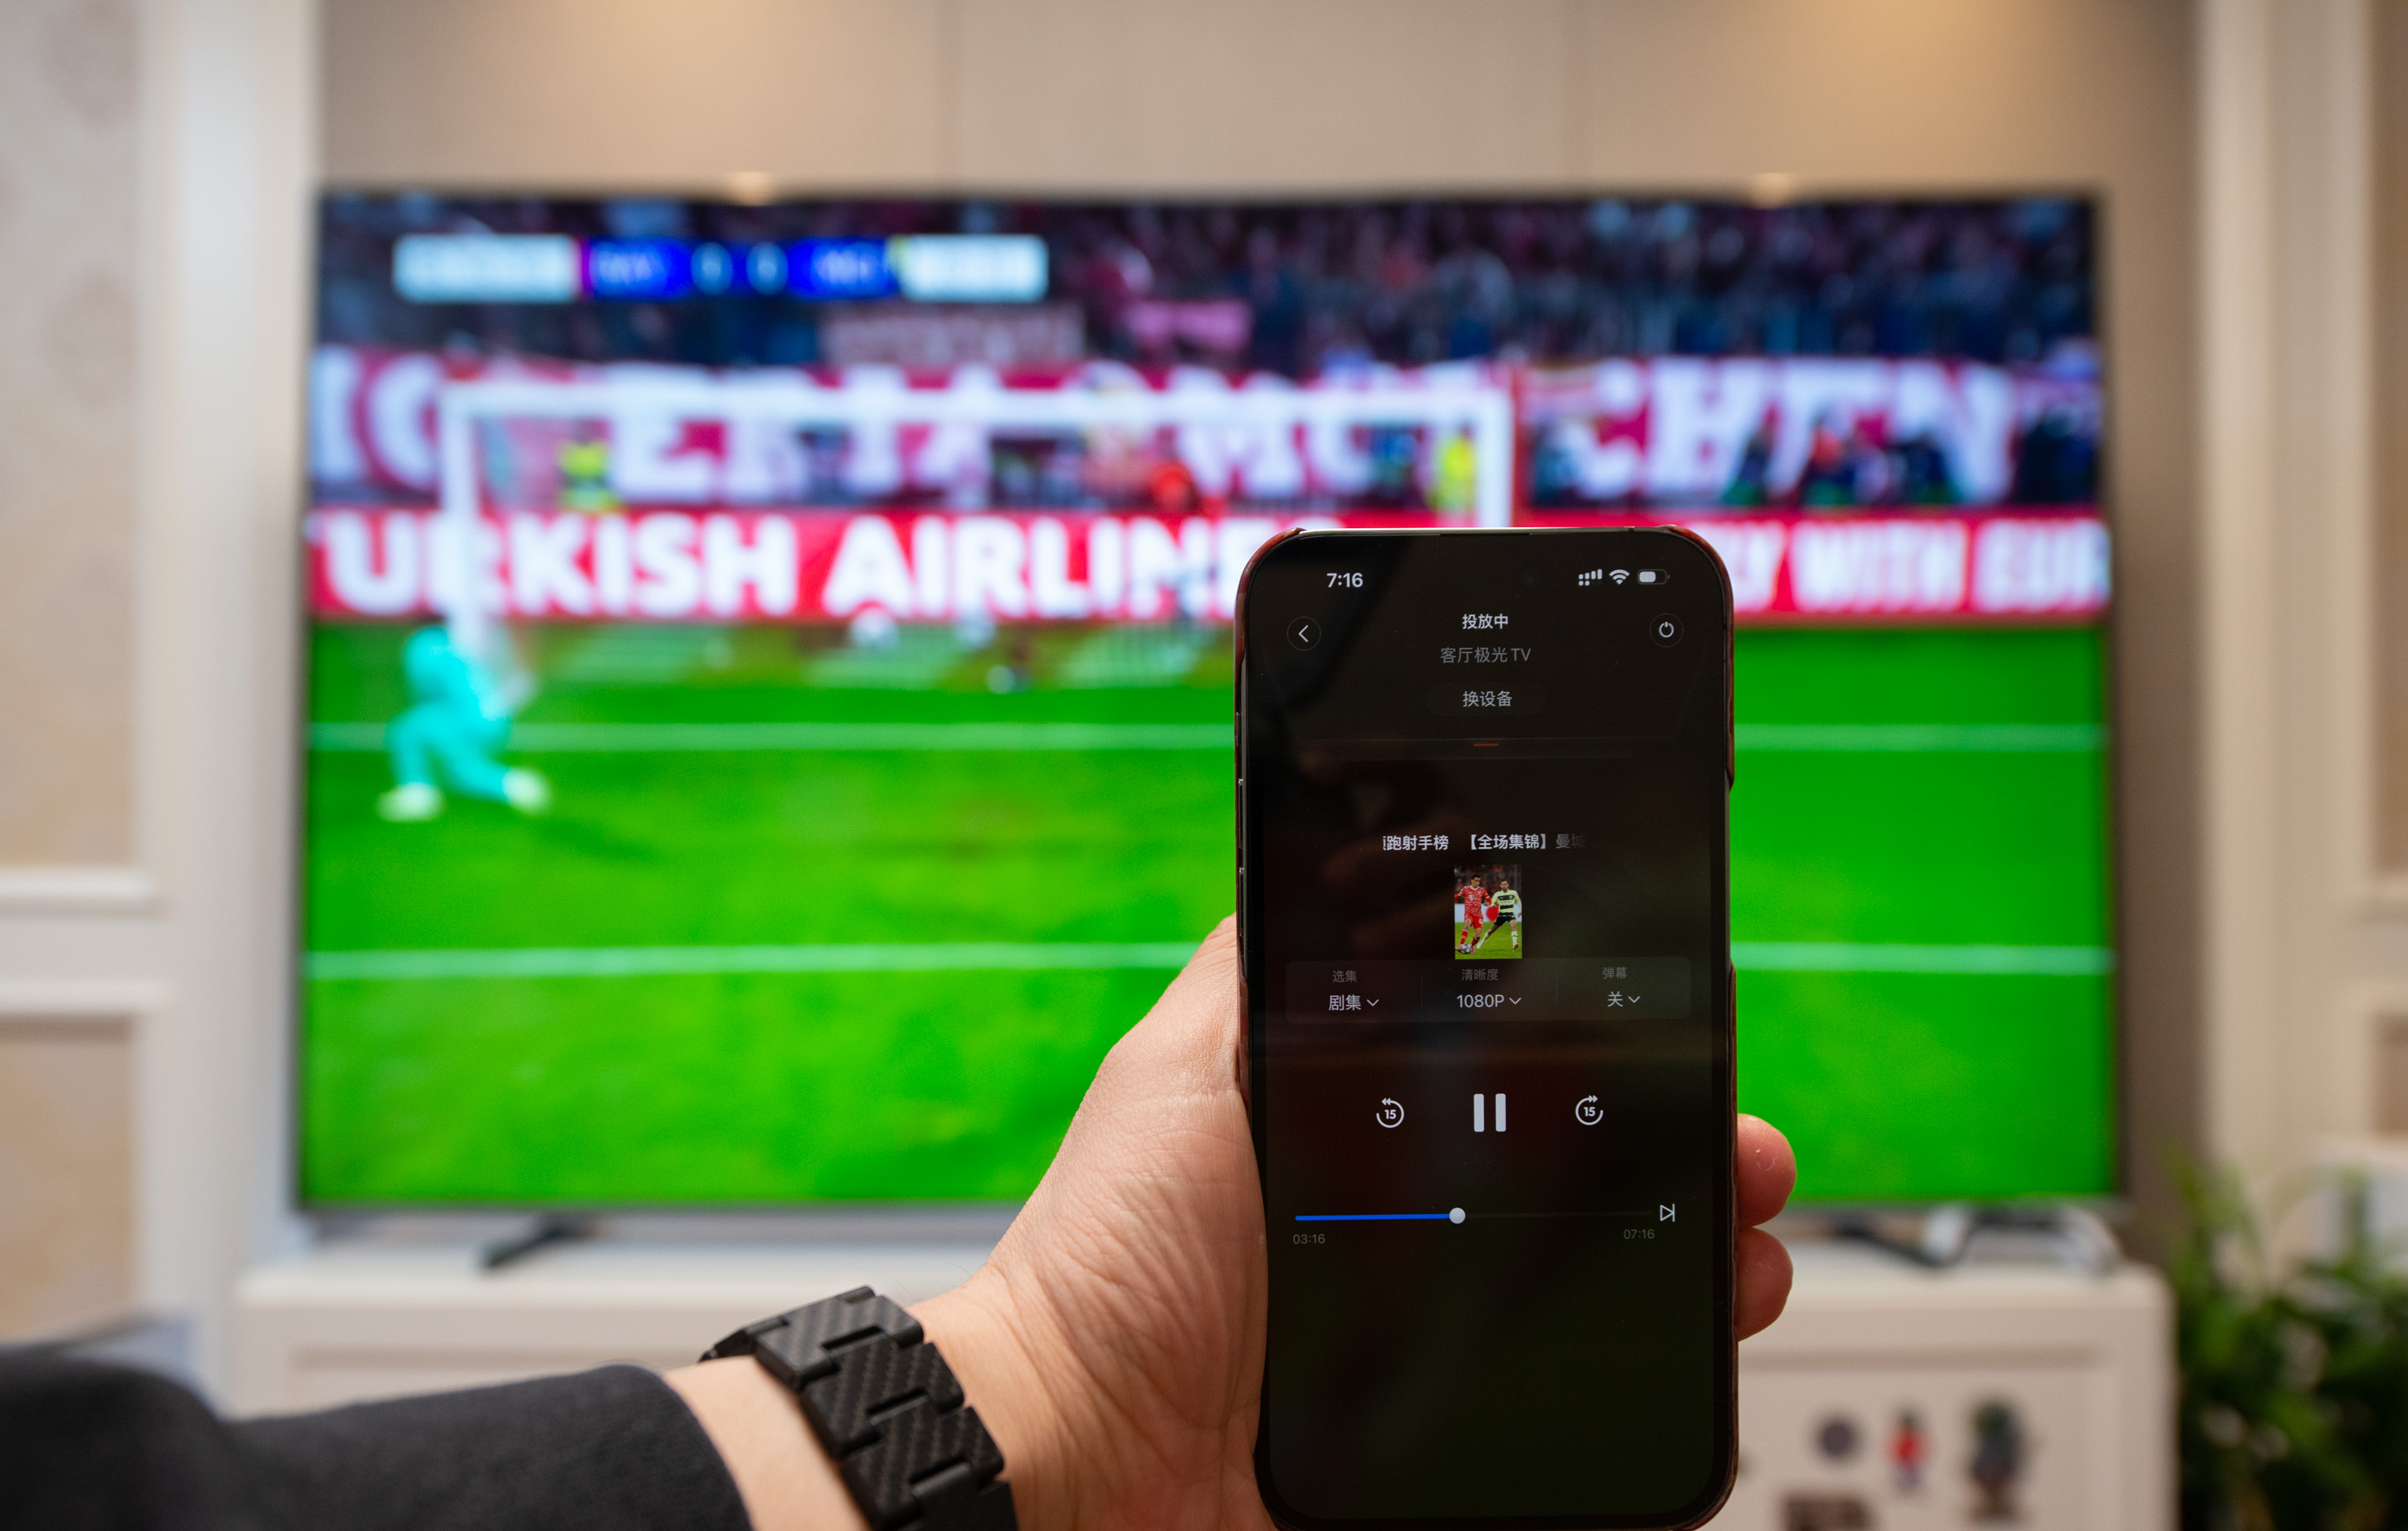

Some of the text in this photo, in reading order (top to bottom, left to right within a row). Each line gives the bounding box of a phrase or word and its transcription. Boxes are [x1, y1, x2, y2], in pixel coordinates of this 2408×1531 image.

[820, 514, 1342, 618] AIRLINE
[1326, 572, 1364, 588] 7:16
[1462, 613, 1508, 629] 投放中
[1462, 690, 1513, 707] 换设备
[1332, 970, 1357, 983] 选集
[1461, 968, 1499, 981] 清晰度
[1602, 967, 1628, 979] 弹幕
[1328, 994, 1361, 1011] 剧集
[1456, 994, 1505, 1008] 1080P
[1607, 991, 1624, 1008] 关
[1384, 1109, 1397, 1120] 15
[1583, 1106, 1596, 1117] 15
[1292, 1233, 1326, 1244] 03:16
[1623, 1228, 1655, 1240] 07:16
